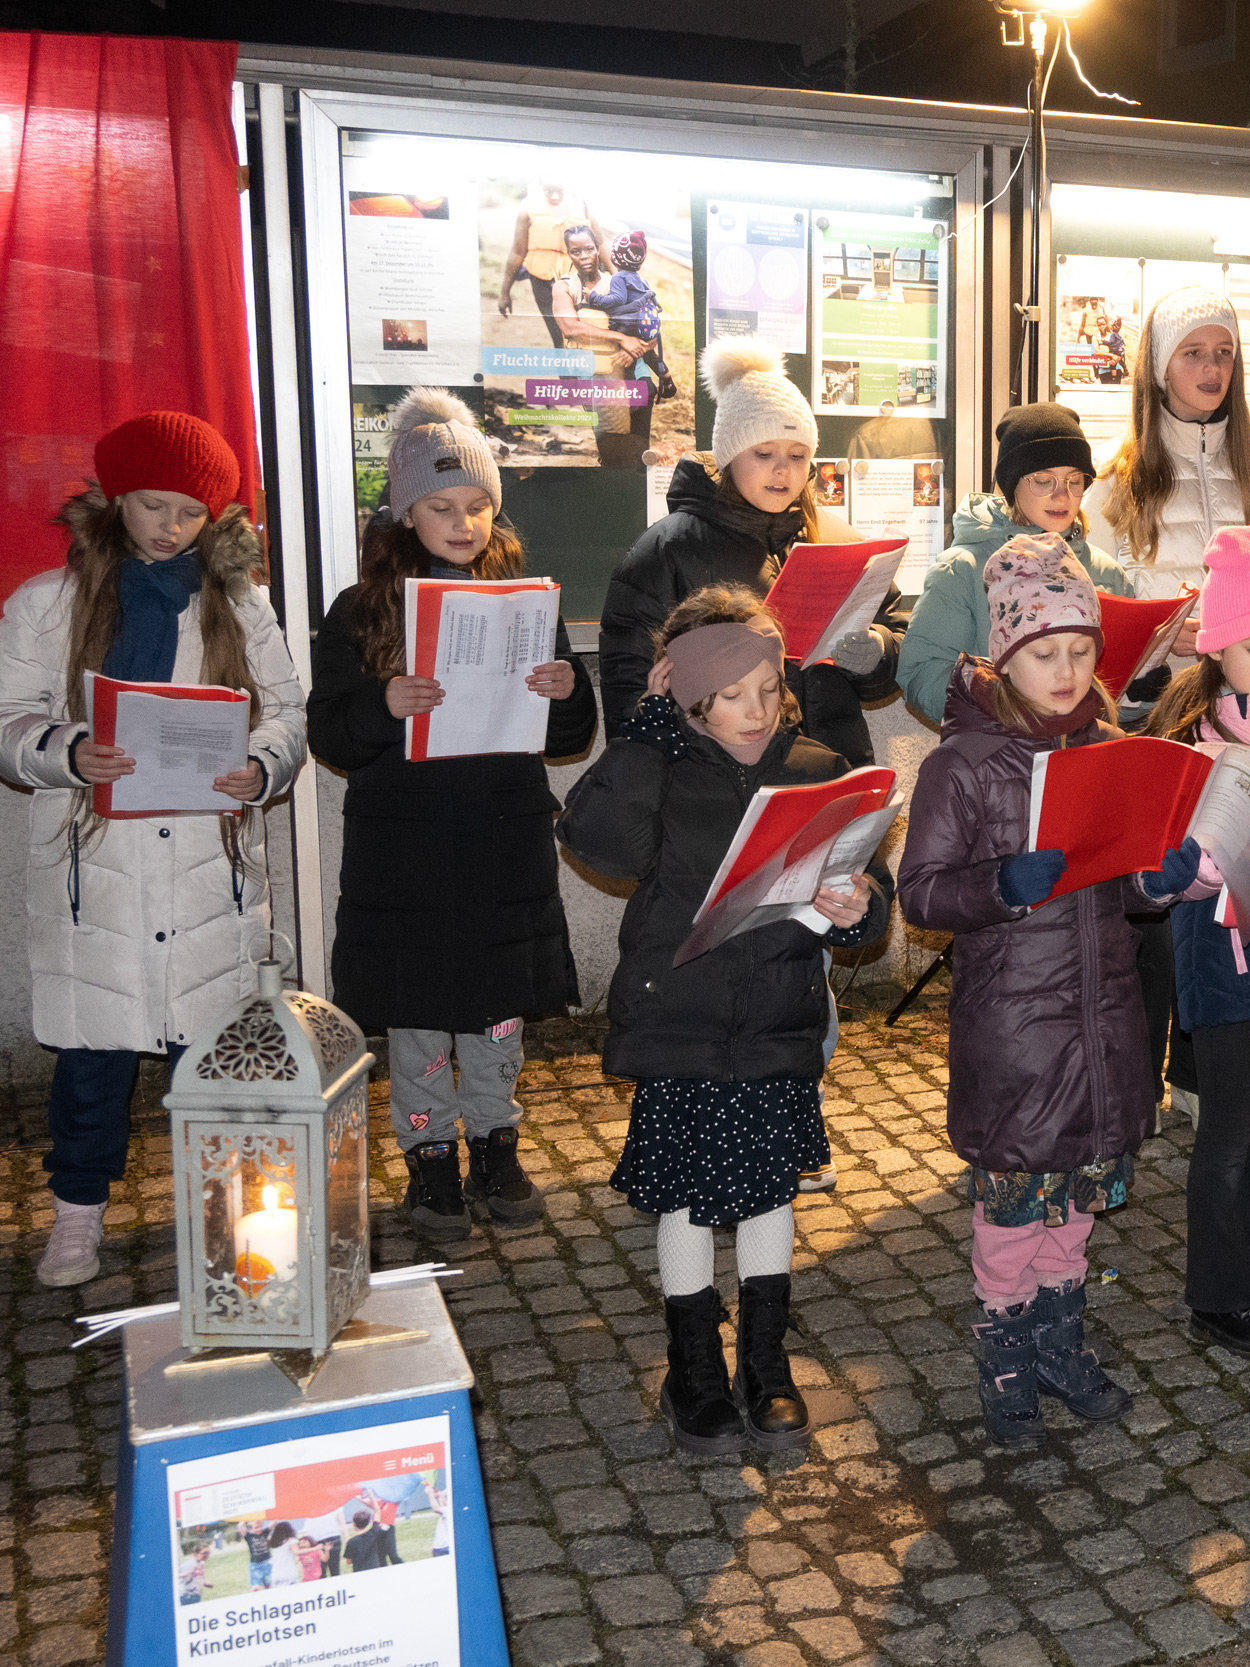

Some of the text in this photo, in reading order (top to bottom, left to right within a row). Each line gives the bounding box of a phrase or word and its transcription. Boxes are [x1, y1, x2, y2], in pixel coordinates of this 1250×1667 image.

[493, 354, 590, 368] Flucht trennt.
[534, 385, 642, 400] Hilfe verbindet.
[514, 413, 576, 422] Weihnachtskollekte
[356, 439, 371, 452] 24
[401, 1452, 434, 1468] Menü
[188, 1589, 356, 1635] Die Schlaganfall-
[190, 1622, 317, 1658] Kinderlotsen
[379, 1638, 394, 1649] im
